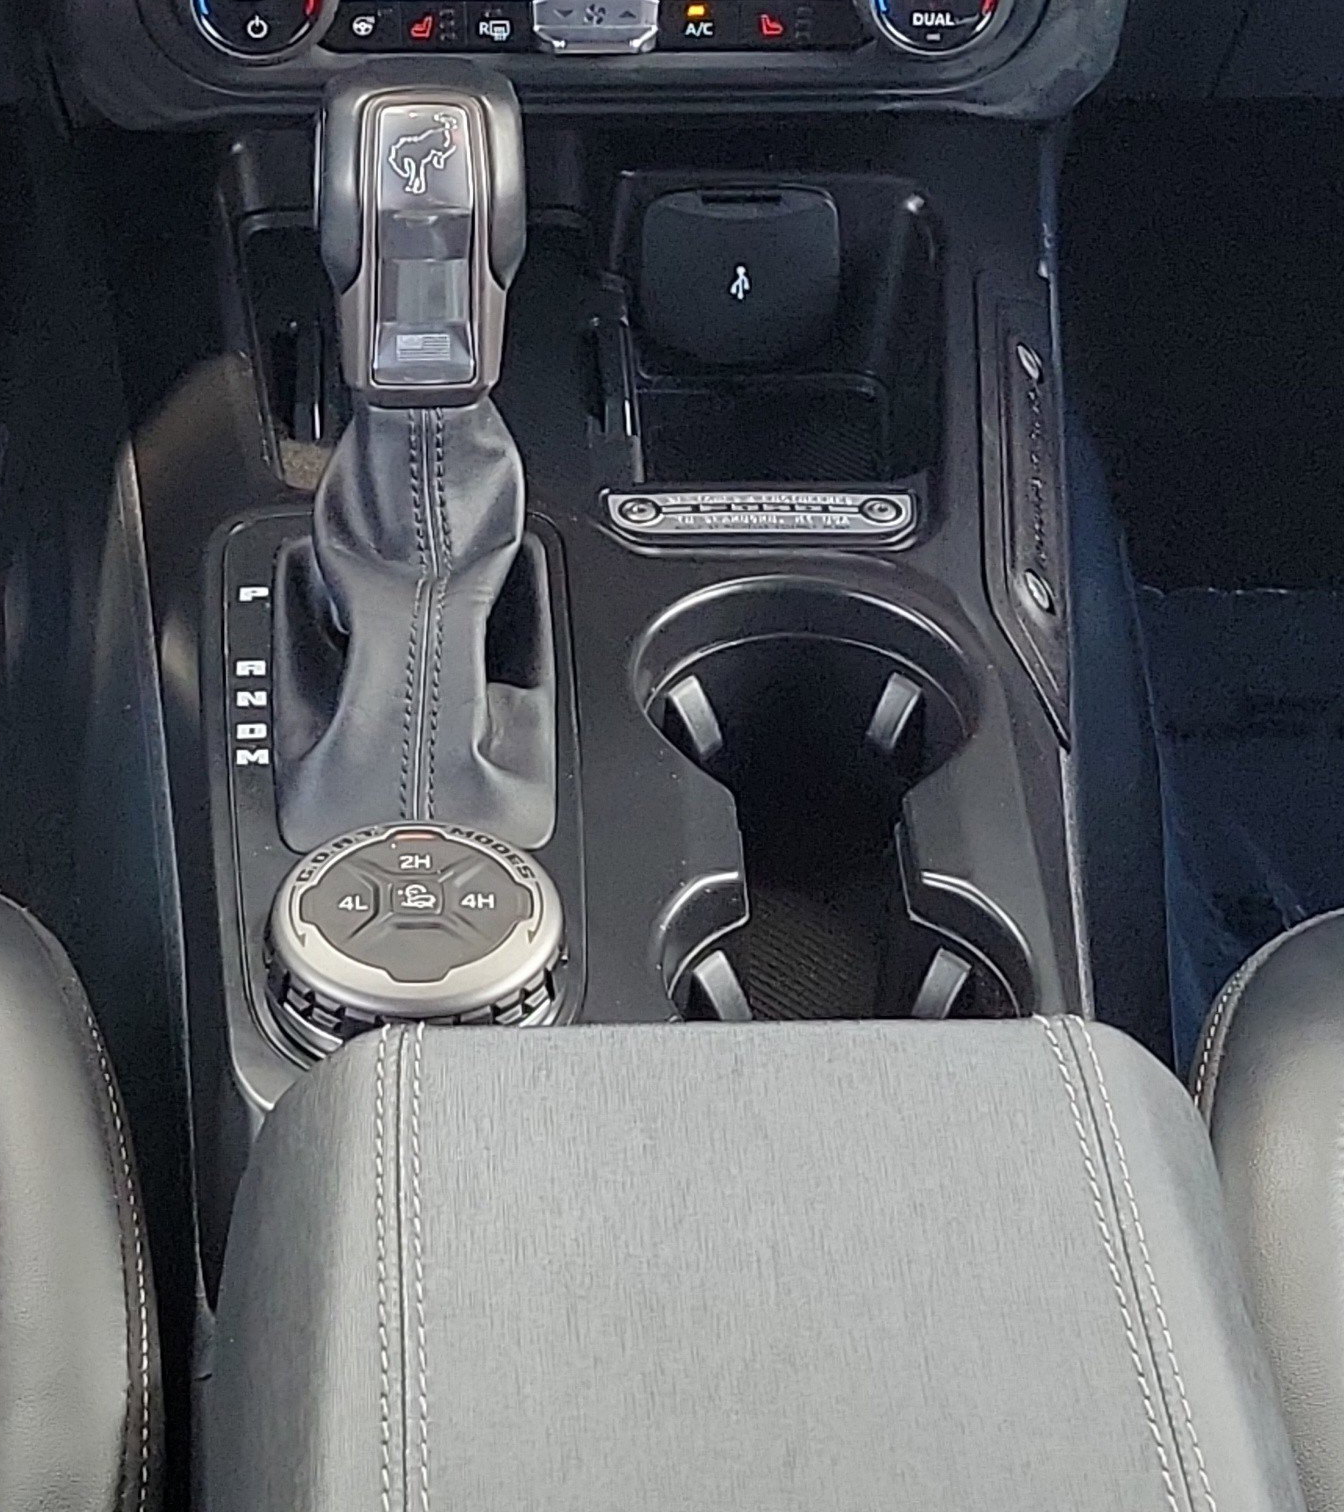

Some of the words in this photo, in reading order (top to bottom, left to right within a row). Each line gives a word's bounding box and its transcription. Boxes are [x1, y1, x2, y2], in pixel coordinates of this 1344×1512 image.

[912, 12, 956, 27] DUAL
[685, 22, 714, 36] A/C
[236, 691, 267, 707] N
[236, 749, 269, 765] M
[450, 826, 536, 880] MODES
[399, 854, 432, 870] 2H
[338, 895, 369, 911] 4L
[460, 893, 495, 909] 4H
